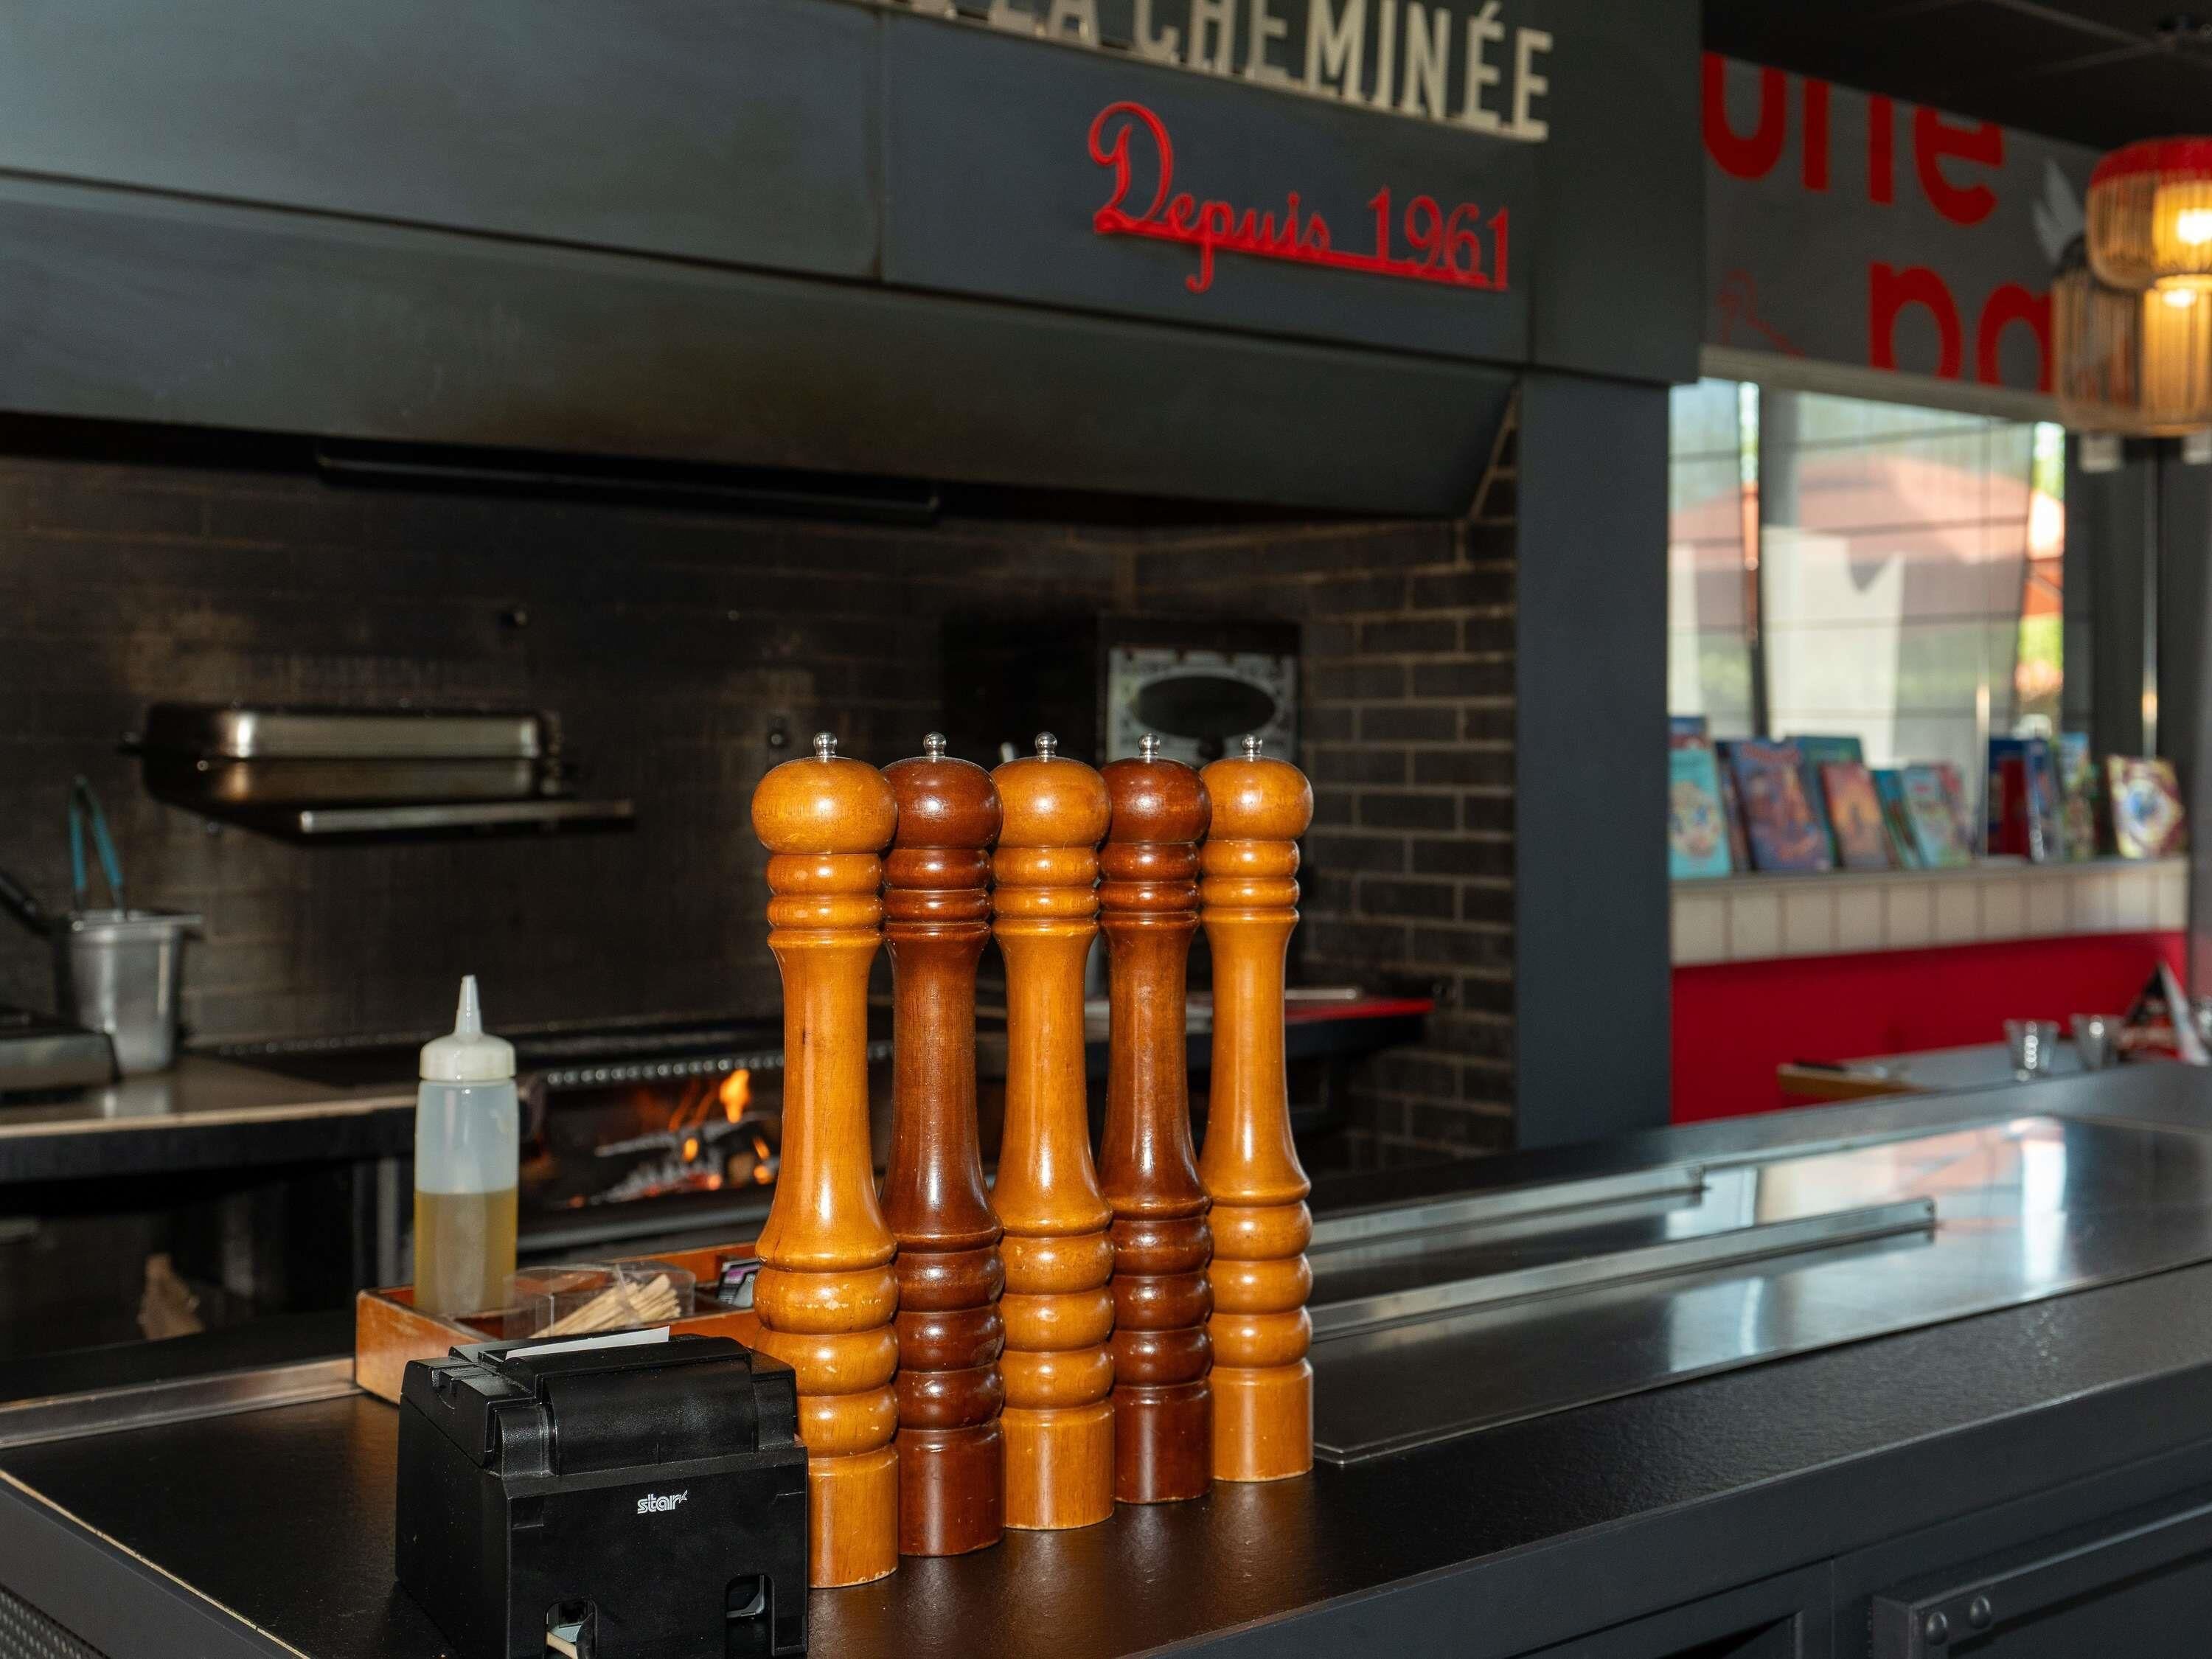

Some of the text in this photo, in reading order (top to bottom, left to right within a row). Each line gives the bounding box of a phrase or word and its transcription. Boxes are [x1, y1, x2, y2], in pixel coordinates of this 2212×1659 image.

[1133, 0, 1553, 142] CHEMINÉE
[1088, 101, 1508, 293] Depuis 1961
[637, 1492, 684, 1514] star
